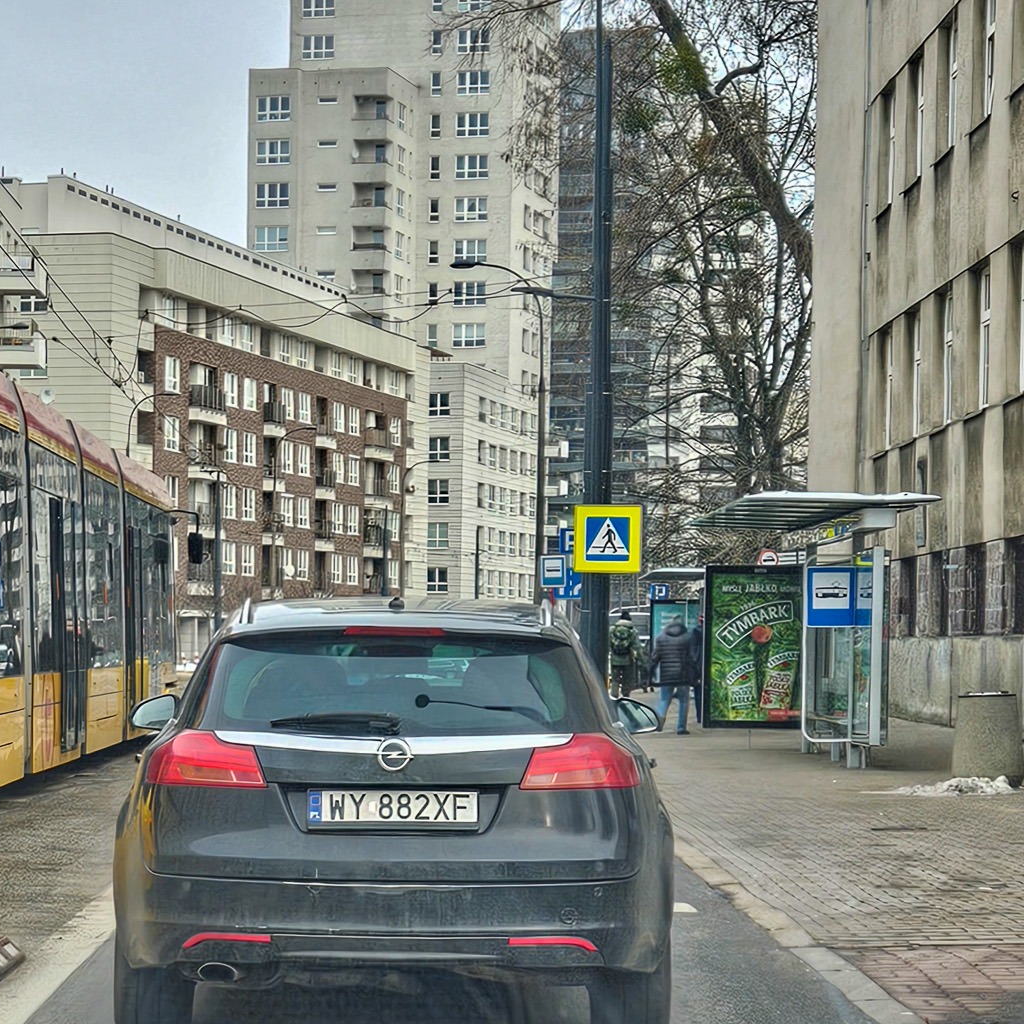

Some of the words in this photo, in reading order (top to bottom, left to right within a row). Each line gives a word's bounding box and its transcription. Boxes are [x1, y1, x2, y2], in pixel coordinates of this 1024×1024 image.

[722, 604, 789, 642] TYMBARK
[329, 793, 366, 820] WY
[378, 793, 470, 820] 882XF
